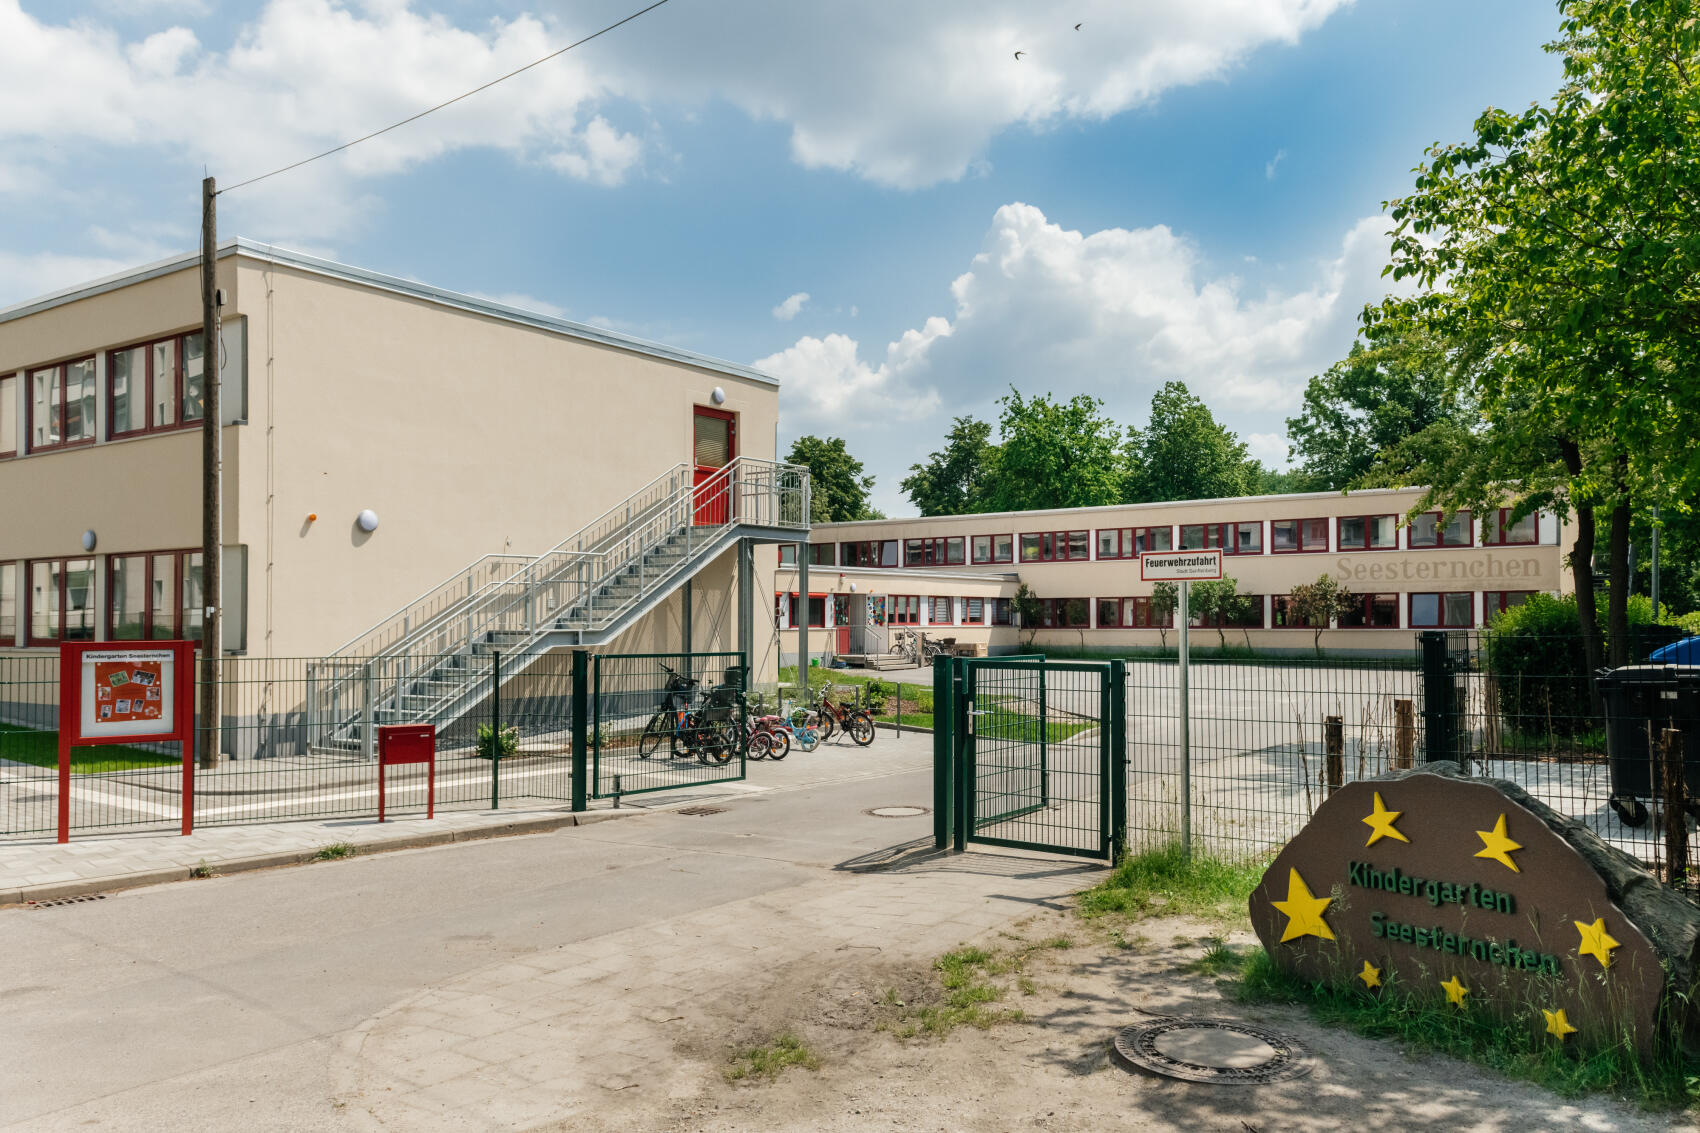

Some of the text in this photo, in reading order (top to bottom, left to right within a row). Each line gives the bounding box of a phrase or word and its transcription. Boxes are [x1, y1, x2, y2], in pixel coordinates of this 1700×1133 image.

[1145, 556, 1217, 568] Feuerwehrzufahrt
[1337, 553, 1542, 581] Seesternchen
[1347, 861, 1516, 915] Kindergarten
[1370, 911, 1563, 976] Seesternchen
